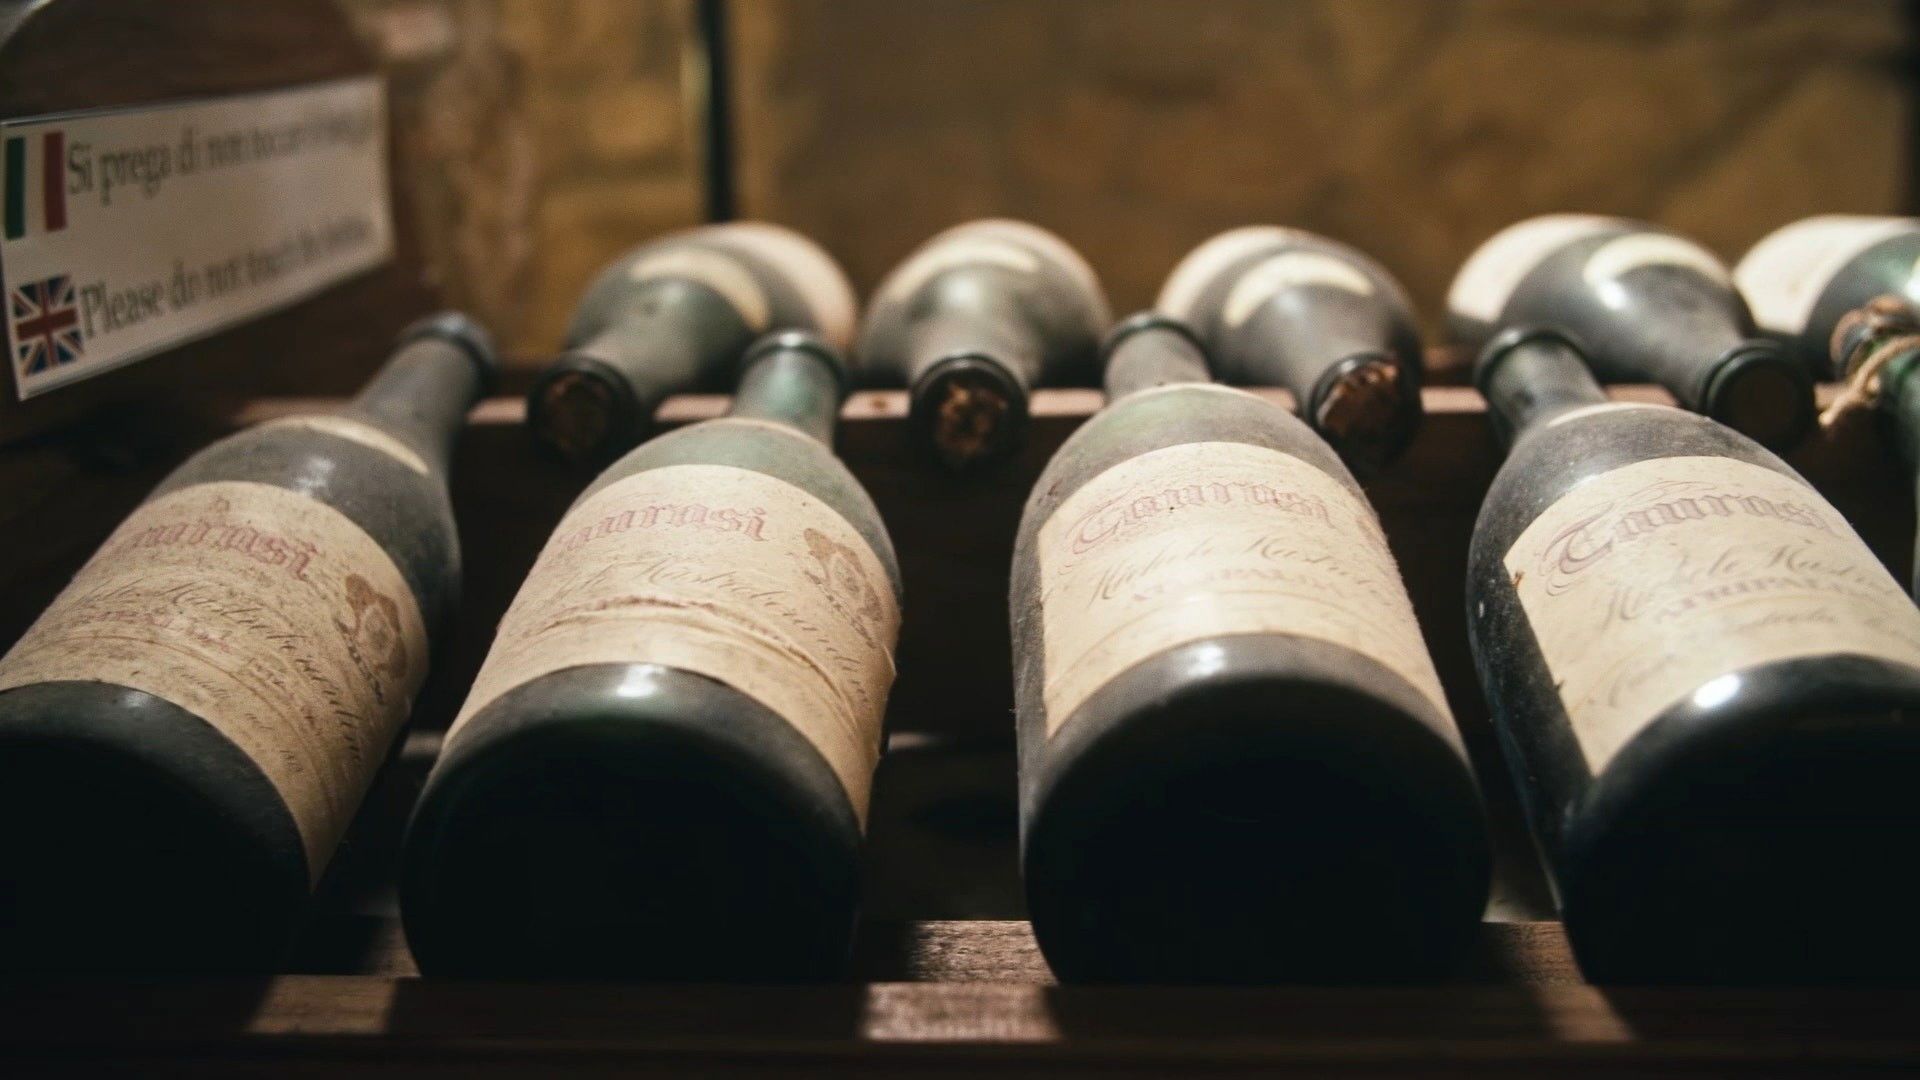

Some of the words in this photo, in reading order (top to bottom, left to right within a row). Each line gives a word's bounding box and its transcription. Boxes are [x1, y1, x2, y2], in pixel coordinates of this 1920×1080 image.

[67, 139, 95, 195] Si
[100, 141, 172, 206] prega
[80, 276, 164, 338] Please
[170, 259, 200, 309] do
[206, 259, 242, 294] not
